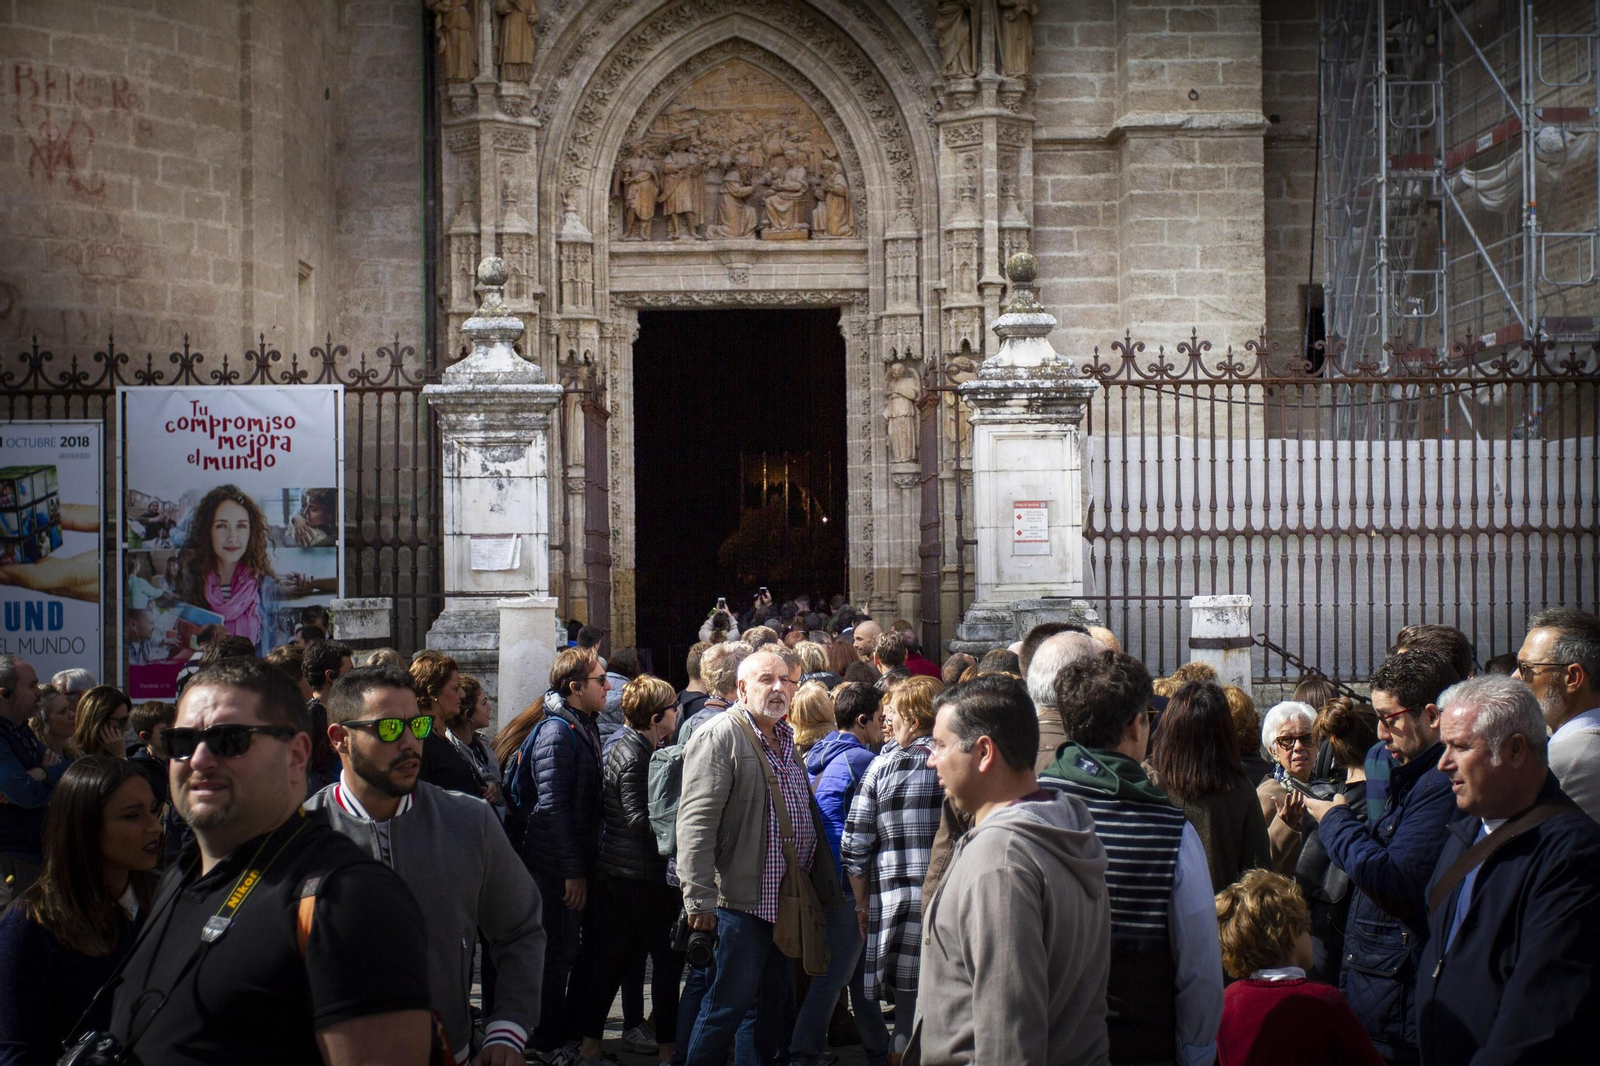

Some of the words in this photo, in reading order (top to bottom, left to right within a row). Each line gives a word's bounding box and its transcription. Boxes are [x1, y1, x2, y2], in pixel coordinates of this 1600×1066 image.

[190, 400, 208, 417] Tu
[165, 414, 296, 440] compromiso
[5, 437, 57, 448] OCTUBRE
[60, 436, 90, 448] 2018
[217, 433, 292, 458] mejora
[187, 448, 200, 466] el
[203, 447, 276, 472] mundo
[4, 601, 64, 632] UND
[0, 637, 14, 655] L
[18, 636, 86, 655] MUNDO
[227, 869, 260, 908] Nikon
